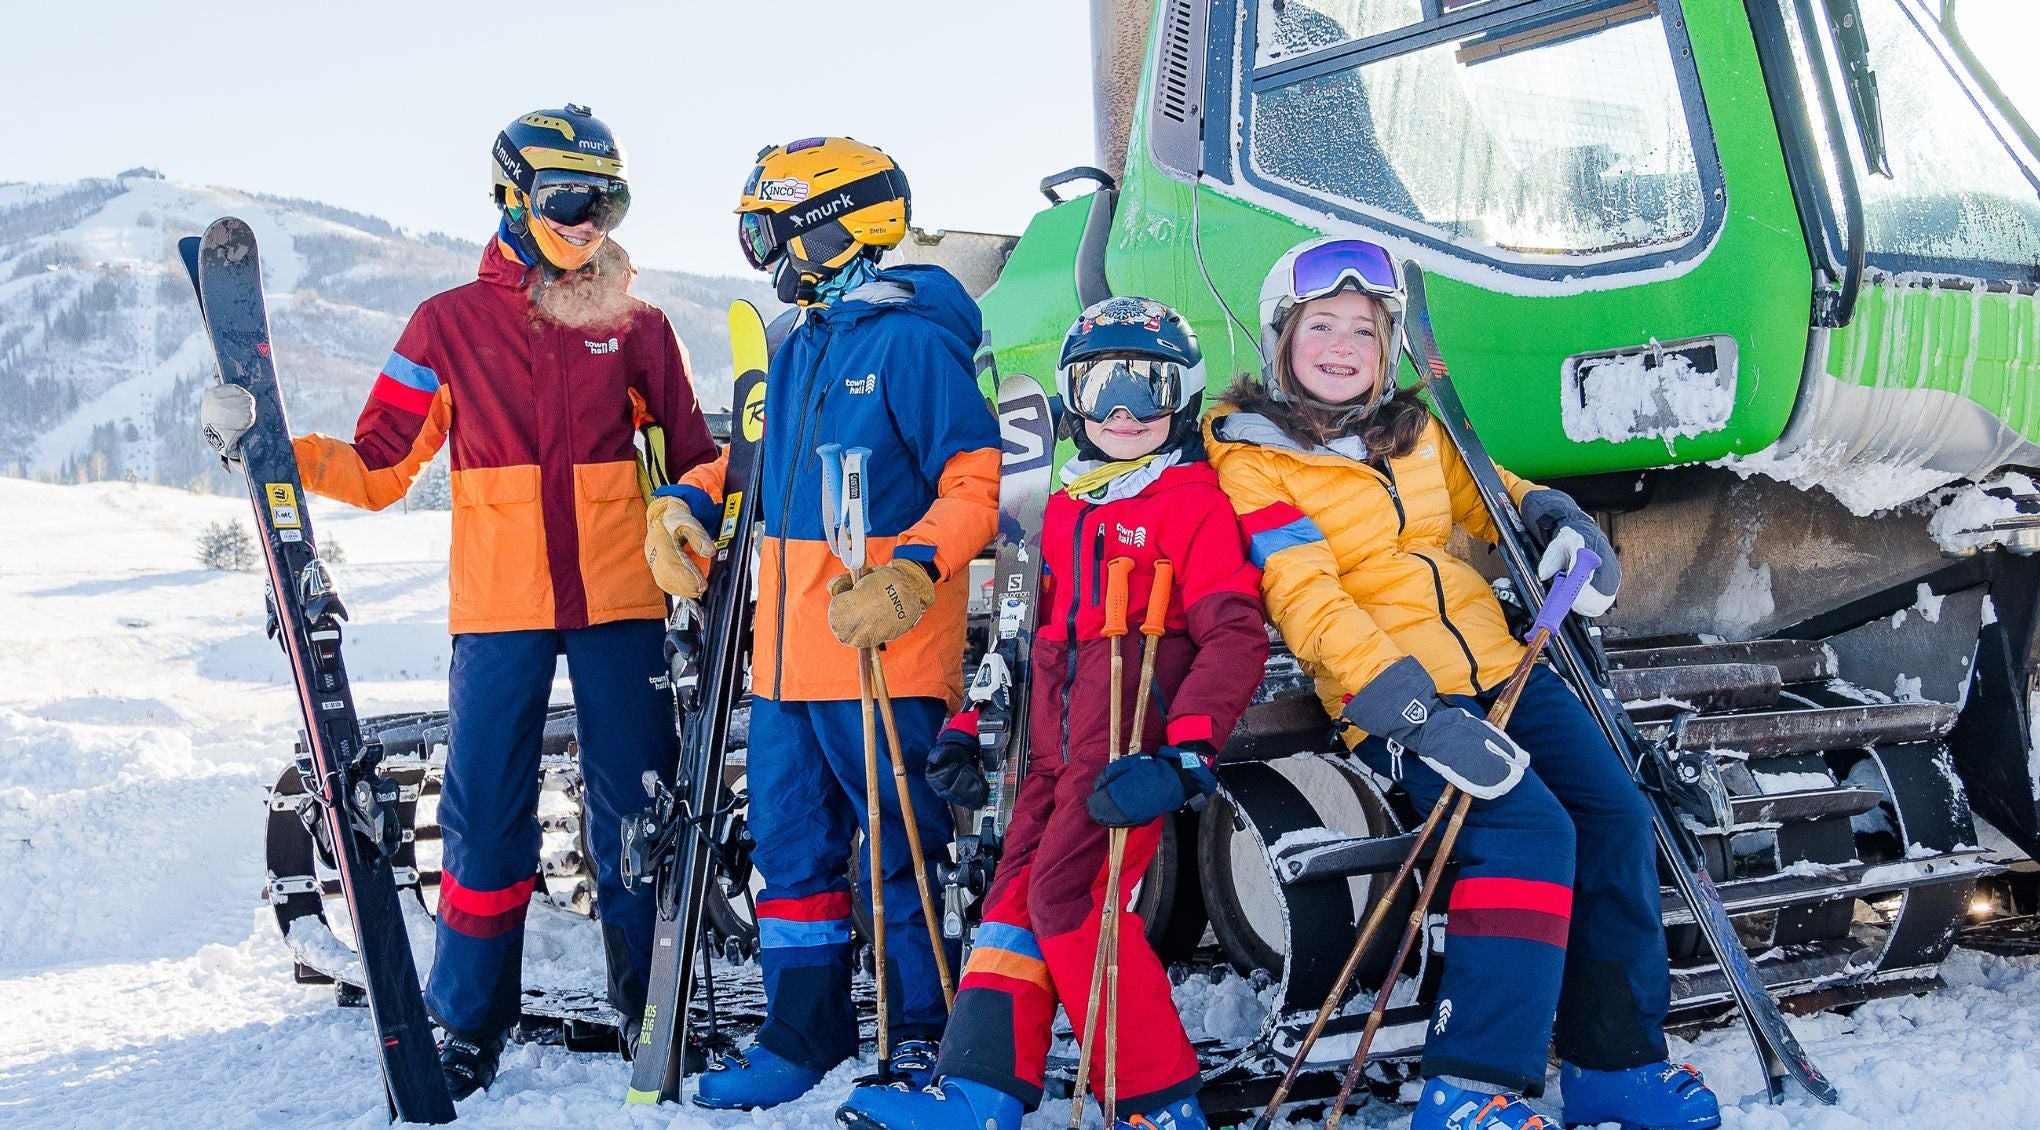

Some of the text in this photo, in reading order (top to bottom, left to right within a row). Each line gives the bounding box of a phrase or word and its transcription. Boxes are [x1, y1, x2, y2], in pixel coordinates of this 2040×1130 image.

[579, 139, 609, 152] murk
[498, 148, 523, 181] murk
[759, 181, 795, 200] KINCO
[805, 193, 855, 225] murk
[585, 340, 608, 348] town
[845, 378, 865, 386] town
[850, 386, 865, 395] hall
[1116, 522, 1134, 537] town
[885, 583, 906, 620] KINCO
[649, 676, 667, 684] town
